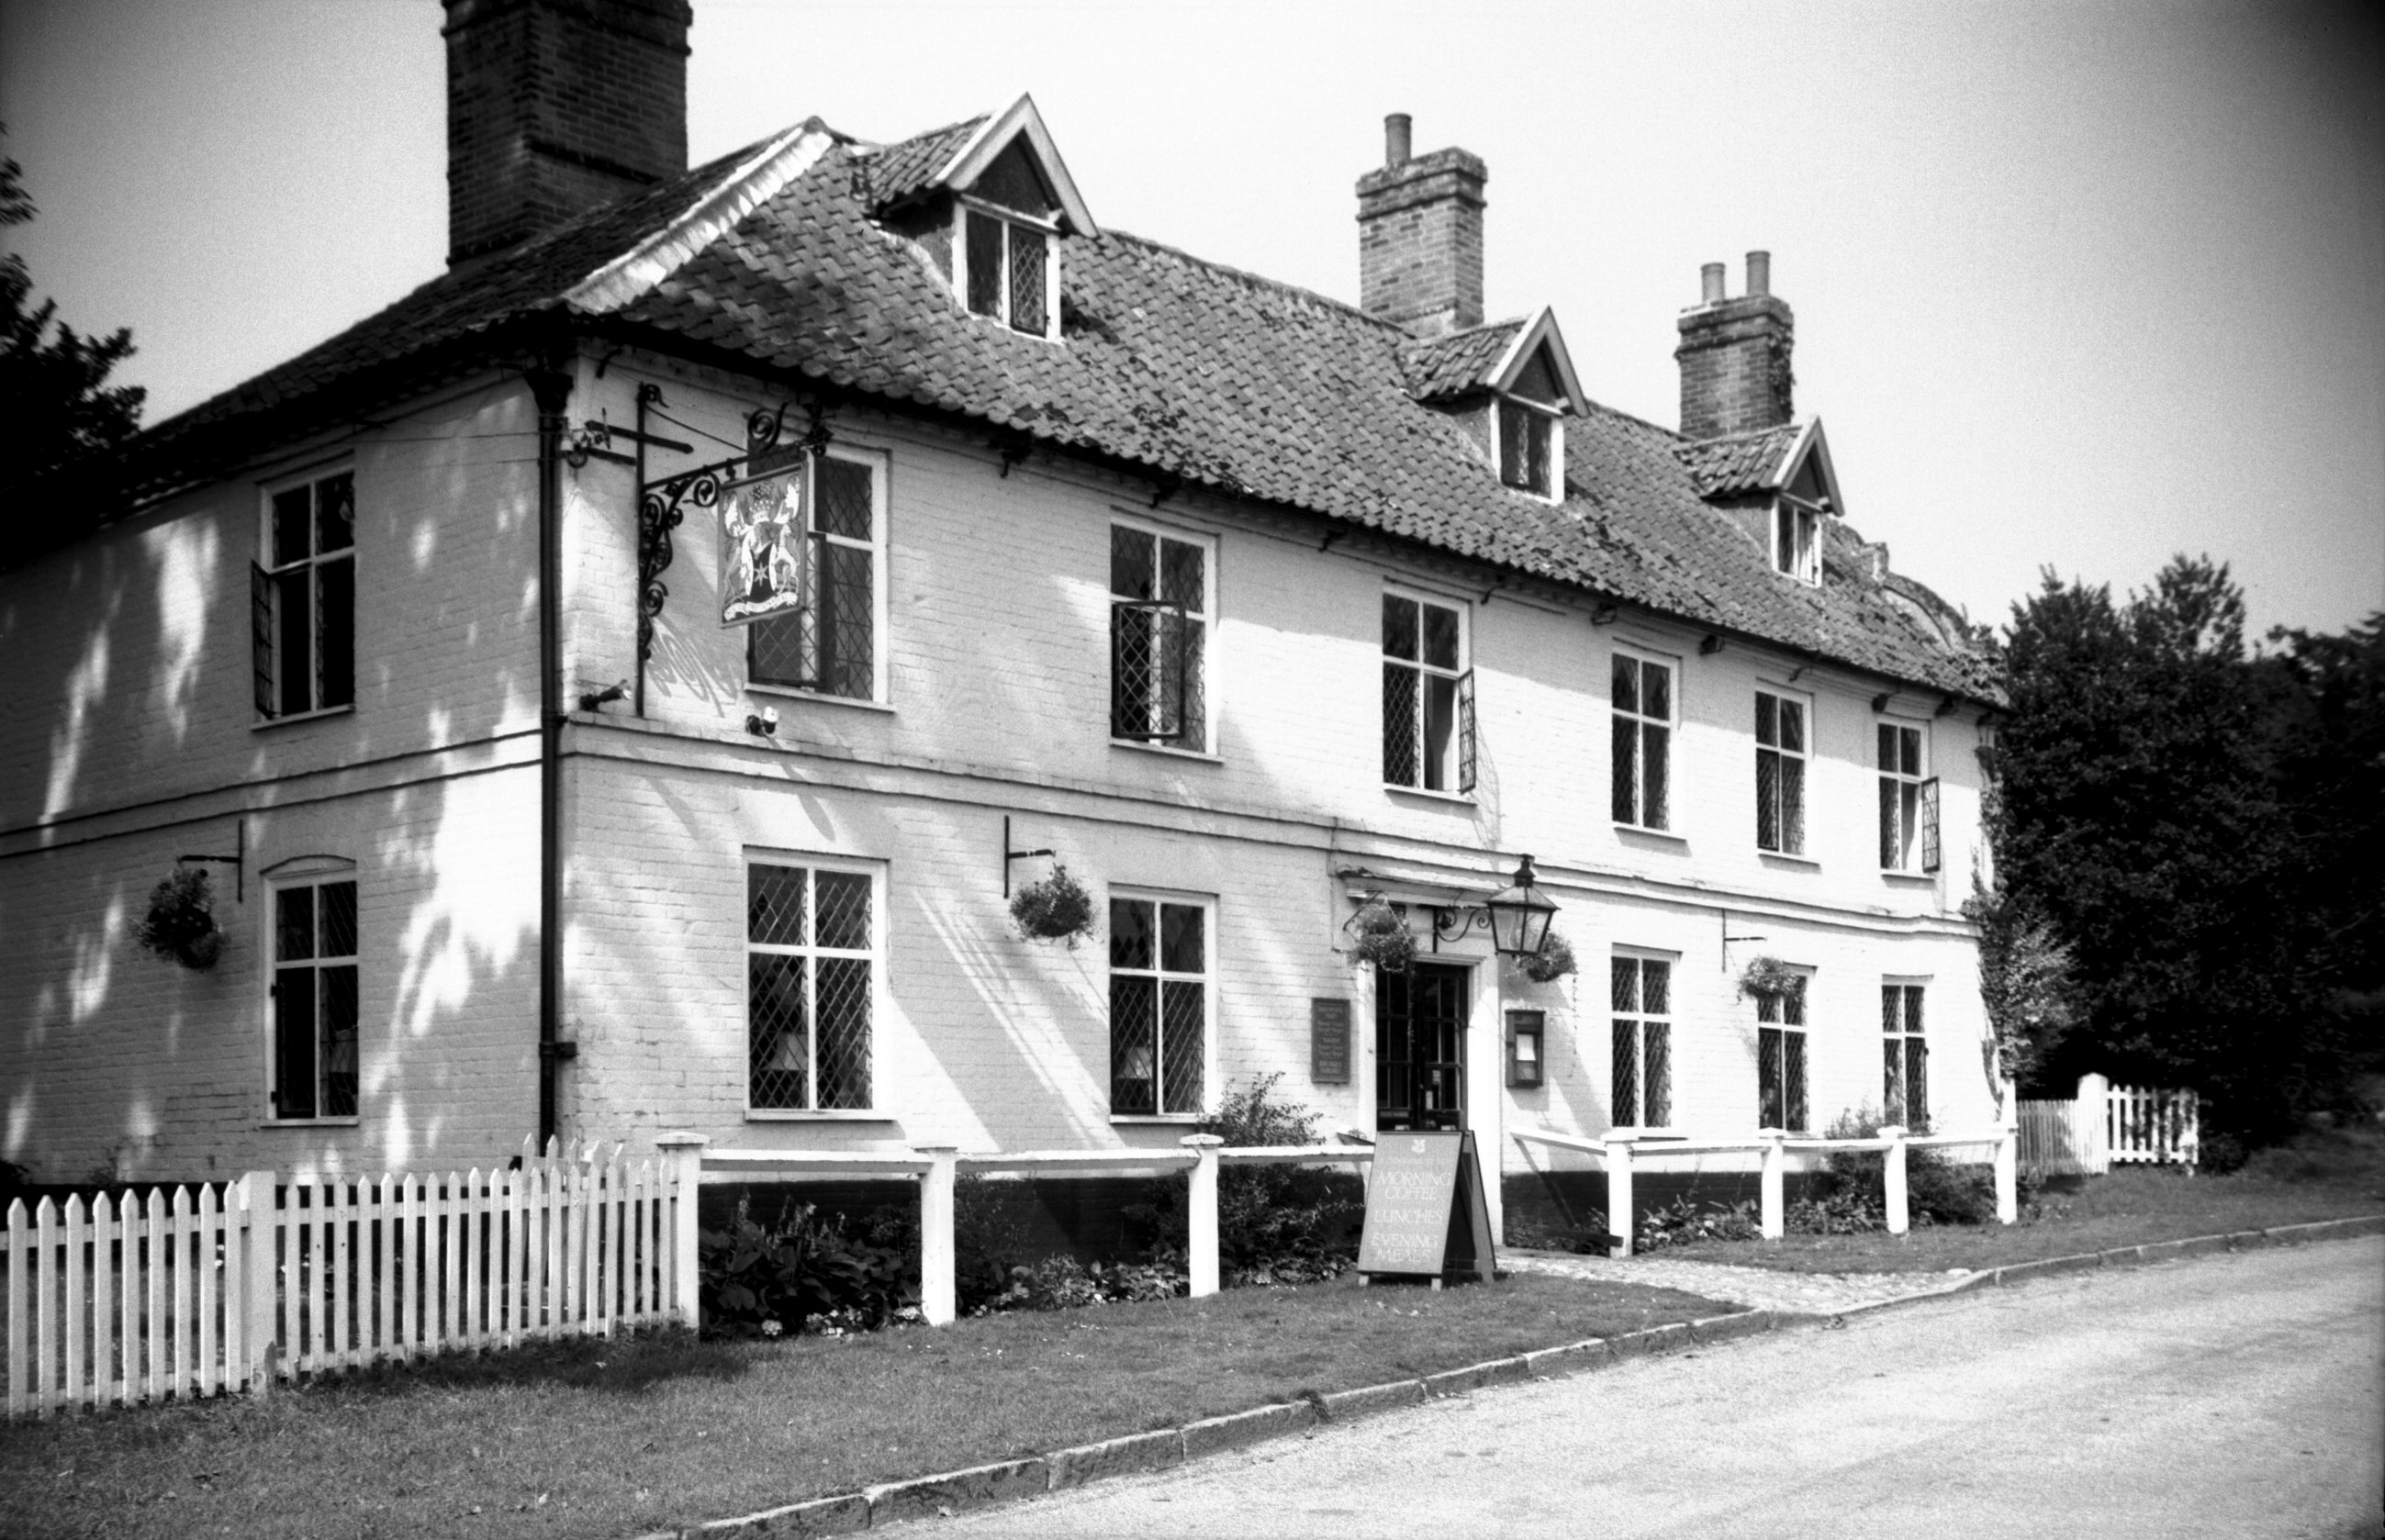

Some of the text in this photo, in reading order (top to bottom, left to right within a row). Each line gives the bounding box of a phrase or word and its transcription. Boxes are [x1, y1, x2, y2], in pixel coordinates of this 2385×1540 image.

[1375, 1171, 1451, 1186] MORNING
[1384, 1186, 1438, 1200] COFFEE
[1374, 1208, 1443, 1223] LUNCHES
[1372, 1232, 1439, 1248] EVENING
[1374, 1248, 1431, 1263] MEALS
